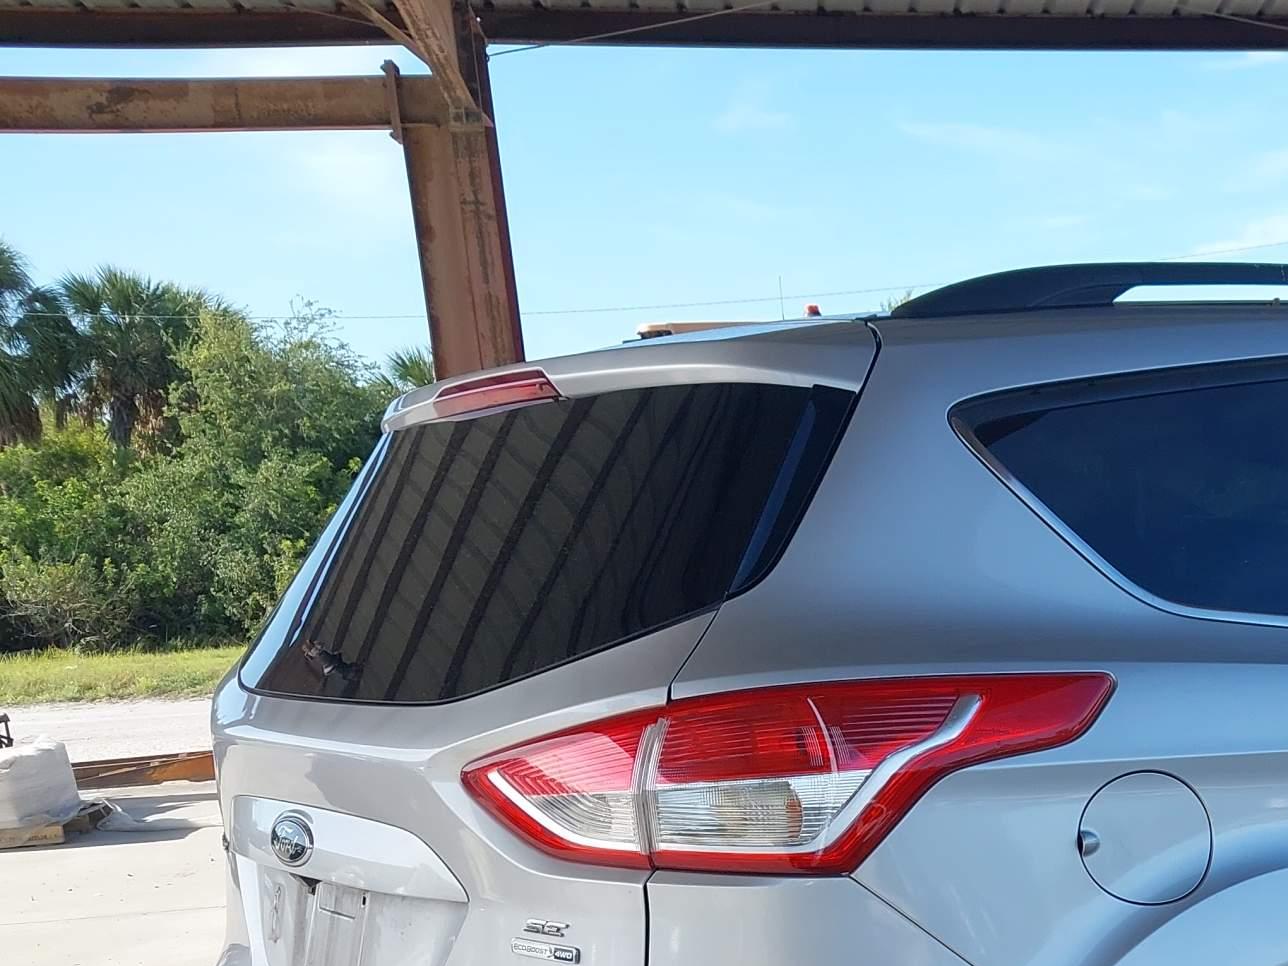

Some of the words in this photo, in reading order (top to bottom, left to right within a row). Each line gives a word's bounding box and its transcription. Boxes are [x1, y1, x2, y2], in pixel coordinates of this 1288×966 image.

[273, 825, 300, 854] Ford
[523, 918, 570, 937] SE
[554, 949, 574, 960] 4WD
